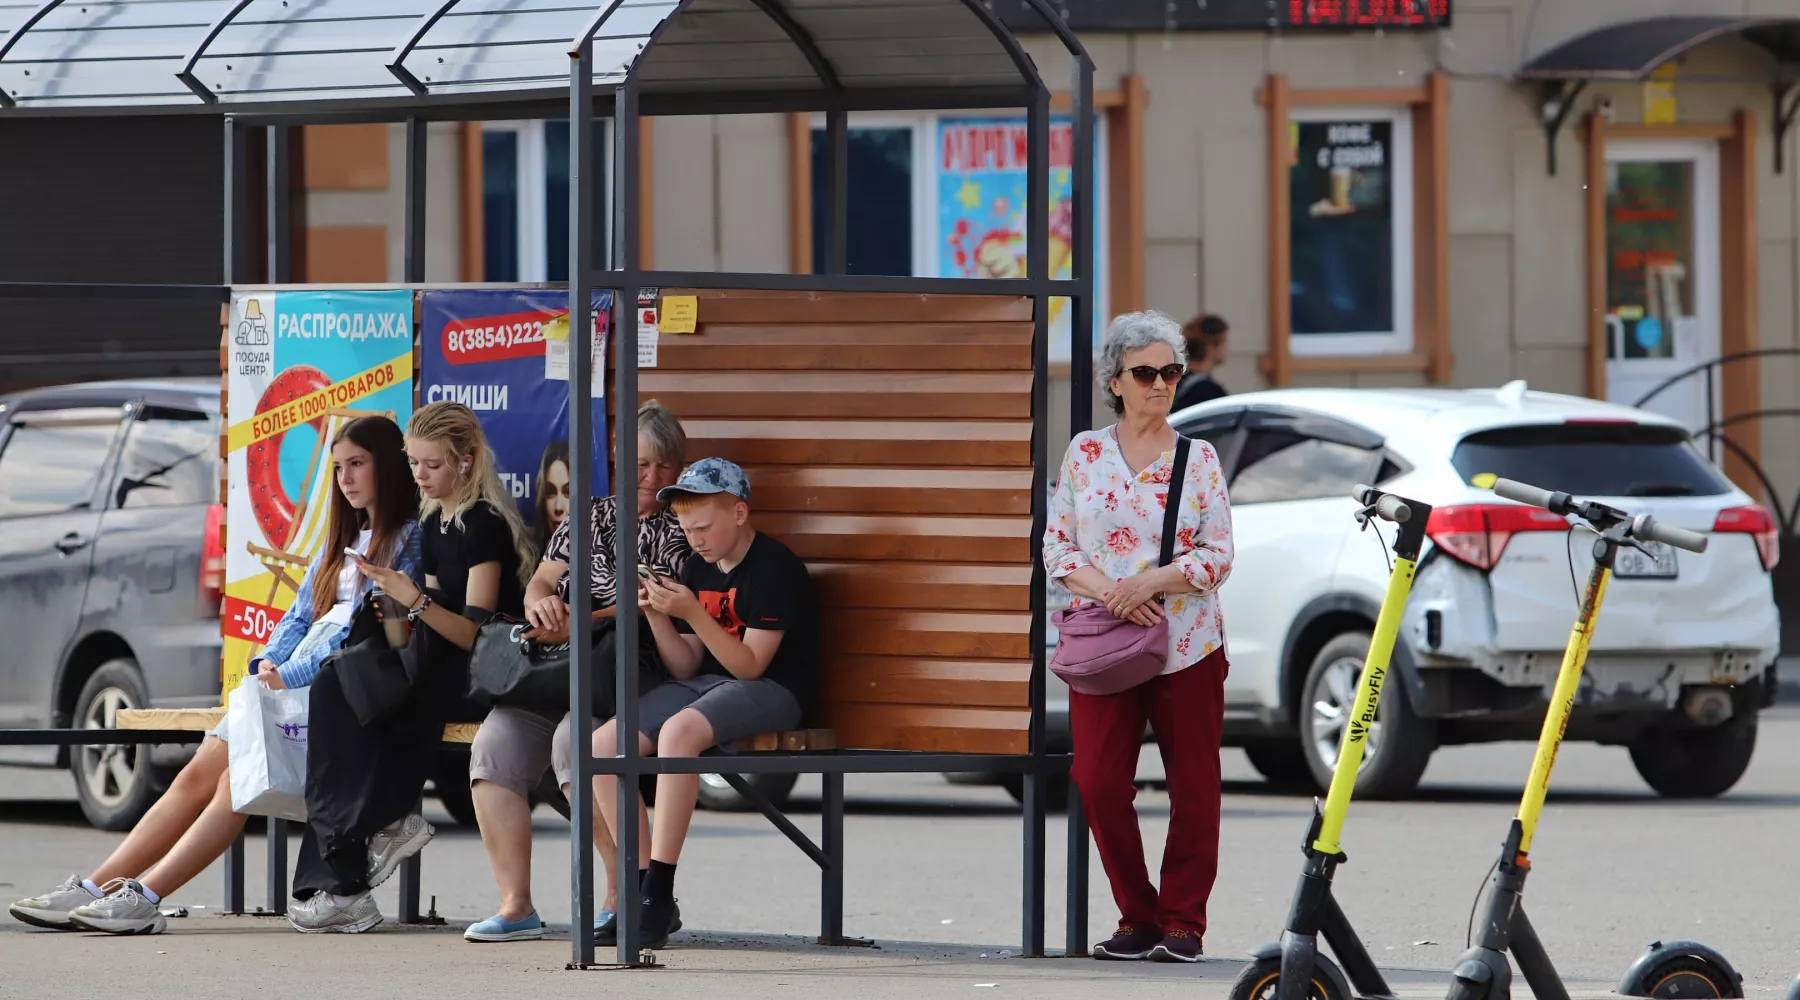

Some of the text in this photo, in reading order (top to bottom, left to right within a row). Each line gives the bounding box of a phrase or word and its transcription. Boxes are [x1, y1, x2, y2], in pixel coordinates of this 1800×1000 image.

[278, 313, 409, 342] РАСПРОДАЖА
[235, 352, 270, 363] ПОСУДА
[252, 364, 394, 439] БОЛЕЕ 1000 ТОВАРОВ
[427, 384, 508, 410] СПИШИ
[1361, 666, 1385, 723] BusyFly
